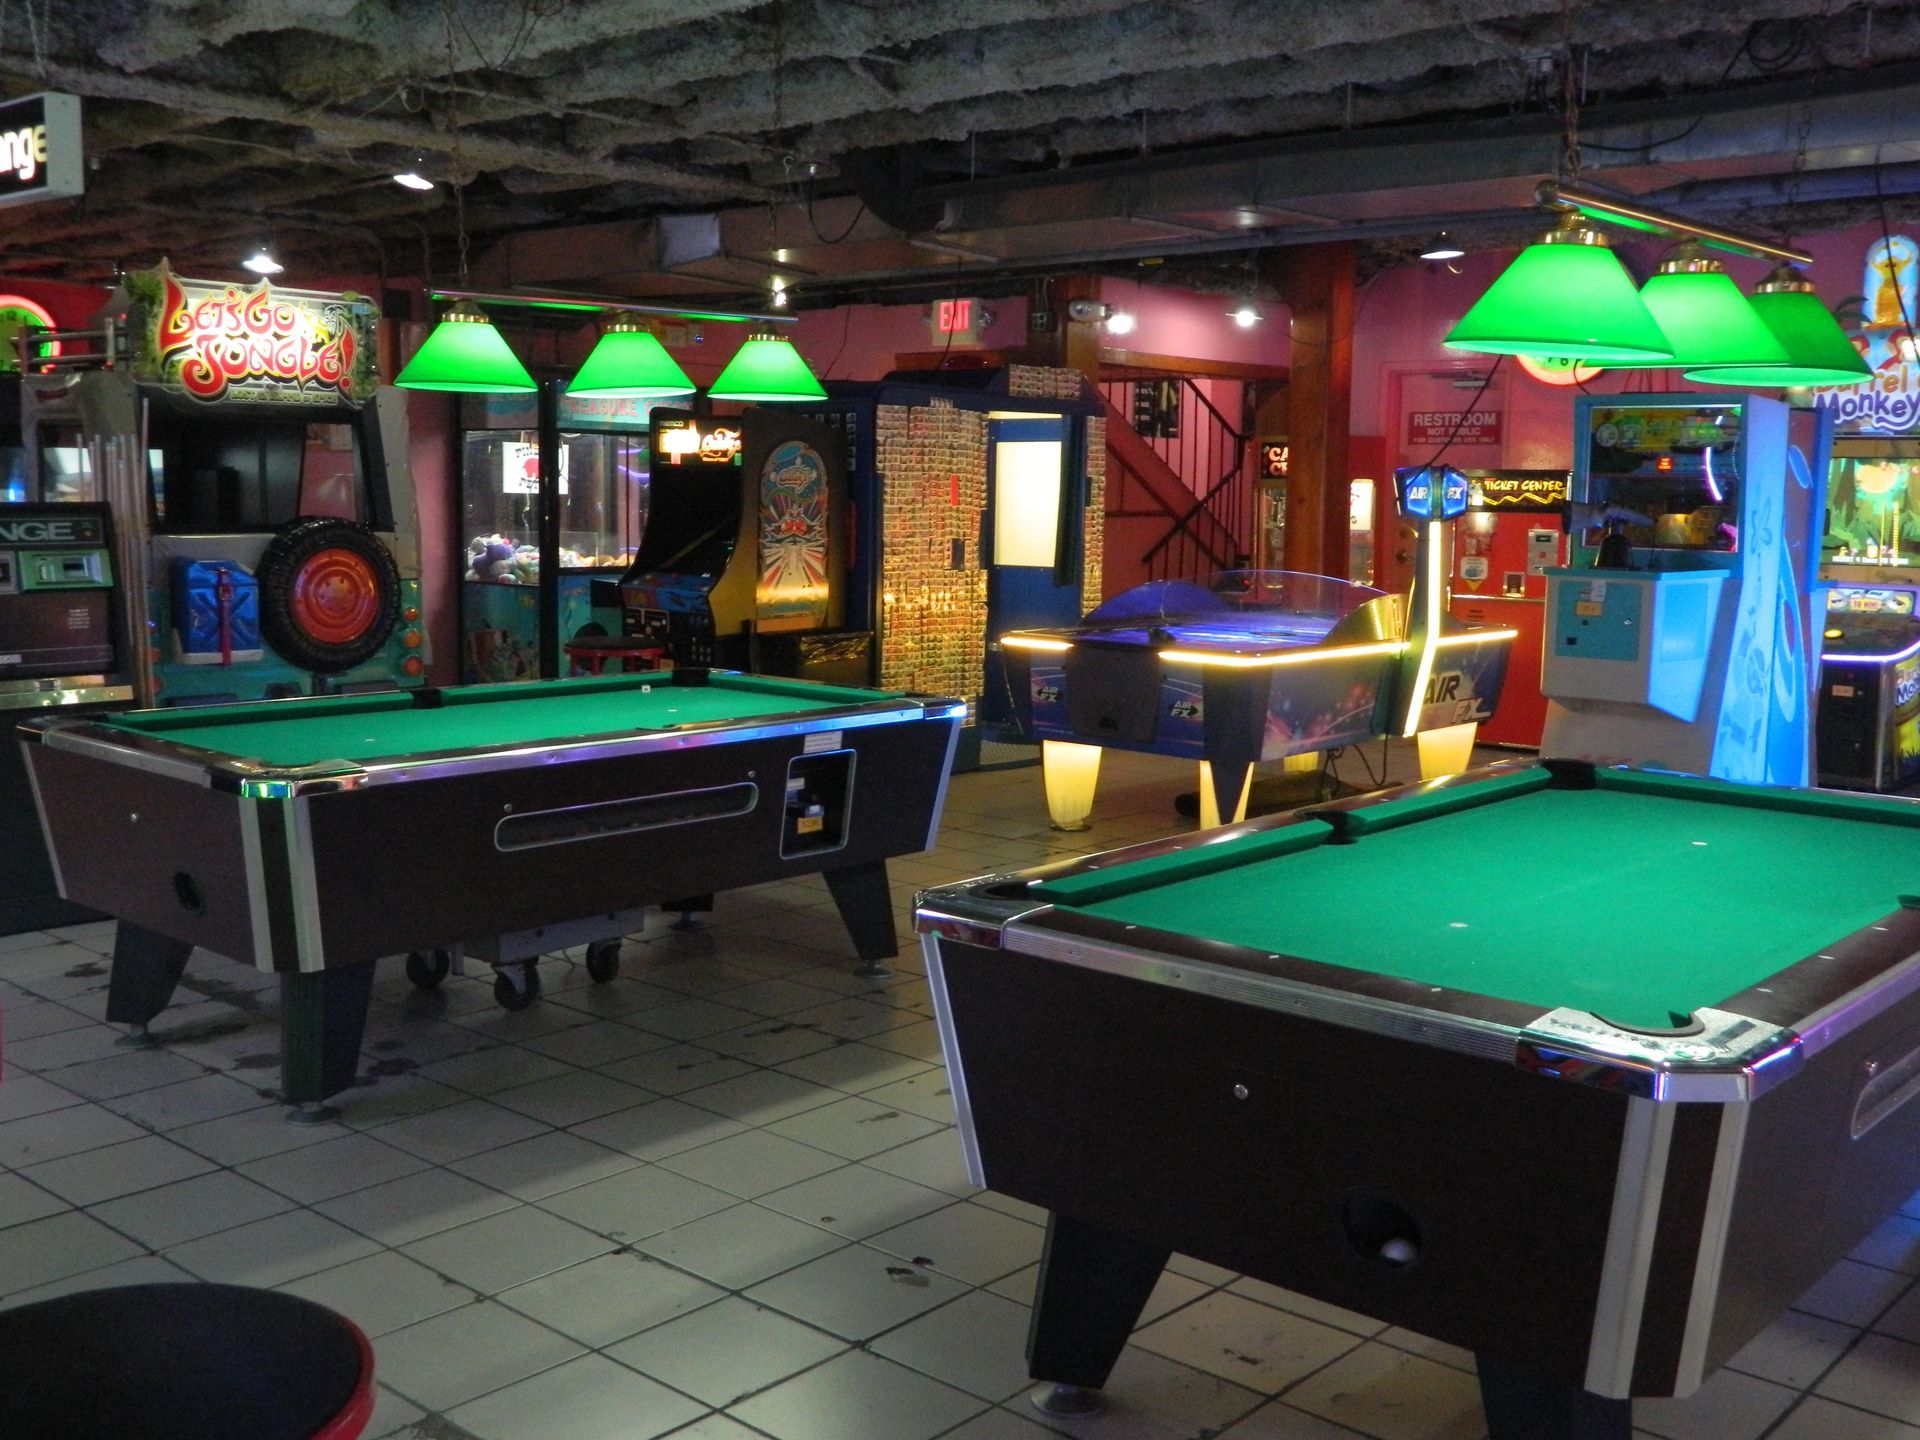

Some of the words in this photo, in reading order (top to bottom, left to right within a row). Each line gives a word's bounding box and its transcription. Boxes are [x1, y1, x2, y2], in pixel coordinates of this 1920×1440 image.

[0, 125, 47, 180] nge
[939, 300, 973, 332] EXIT
[1414, 412, 1496, 427] RESTROOM
[1427, 427, 1446, 436] NOT
[1485, 480, 1519, 491] TICKET
[1521, 480, 1564, 491] CENTER
[1409, 487, 1428, 499] AIR
[1447, 487, 1462, 499] FX
